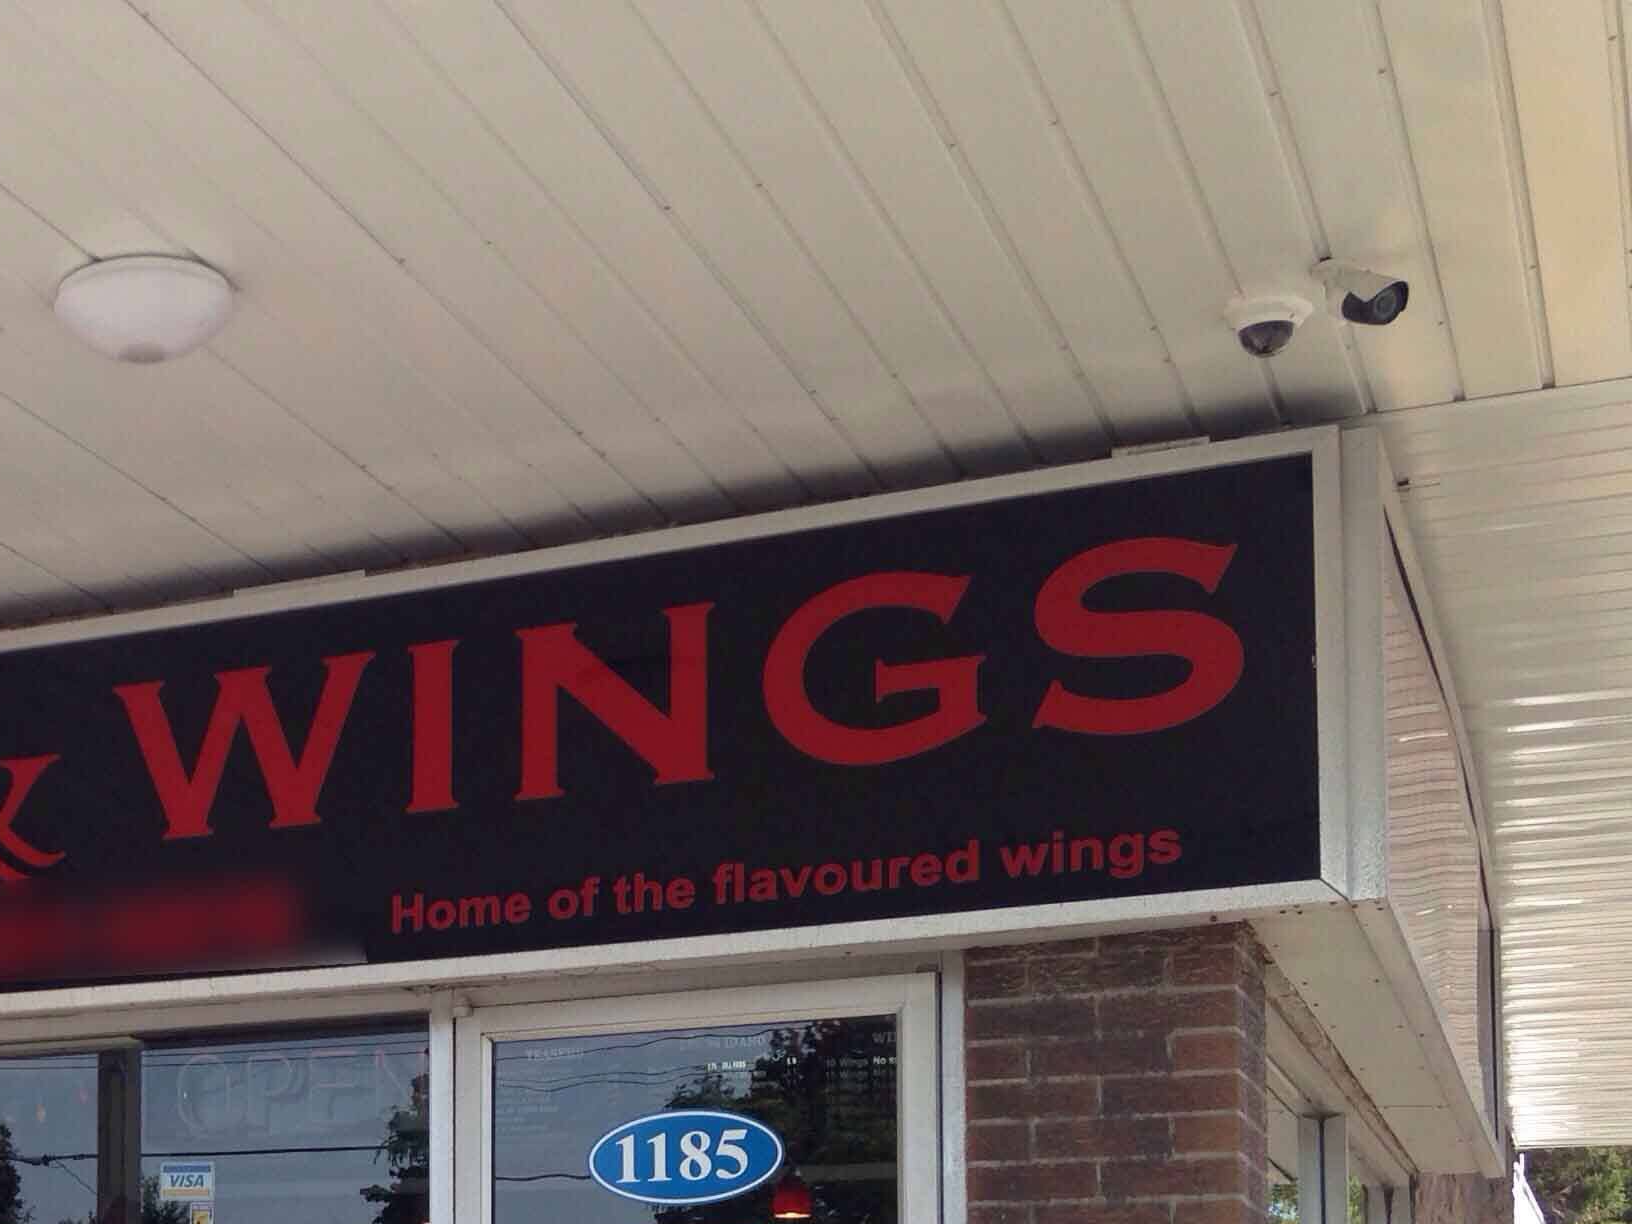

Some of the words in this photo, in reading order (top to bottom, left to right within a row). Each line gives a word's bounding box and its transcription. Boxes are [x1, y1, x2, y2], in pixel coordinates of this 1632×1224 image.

[113, 536, 1245, 840] WINGS
[391, 893, 531, 934] Home
[548, 876, 600, 920] of
[613, 872, 695, 913] the
[712, 840, 979, 905] flavoured
[999, 827, 1182, 879] wings
[170, 1174, 205, 1188] VISA
[615, 1129, 748, 1183] 1185
